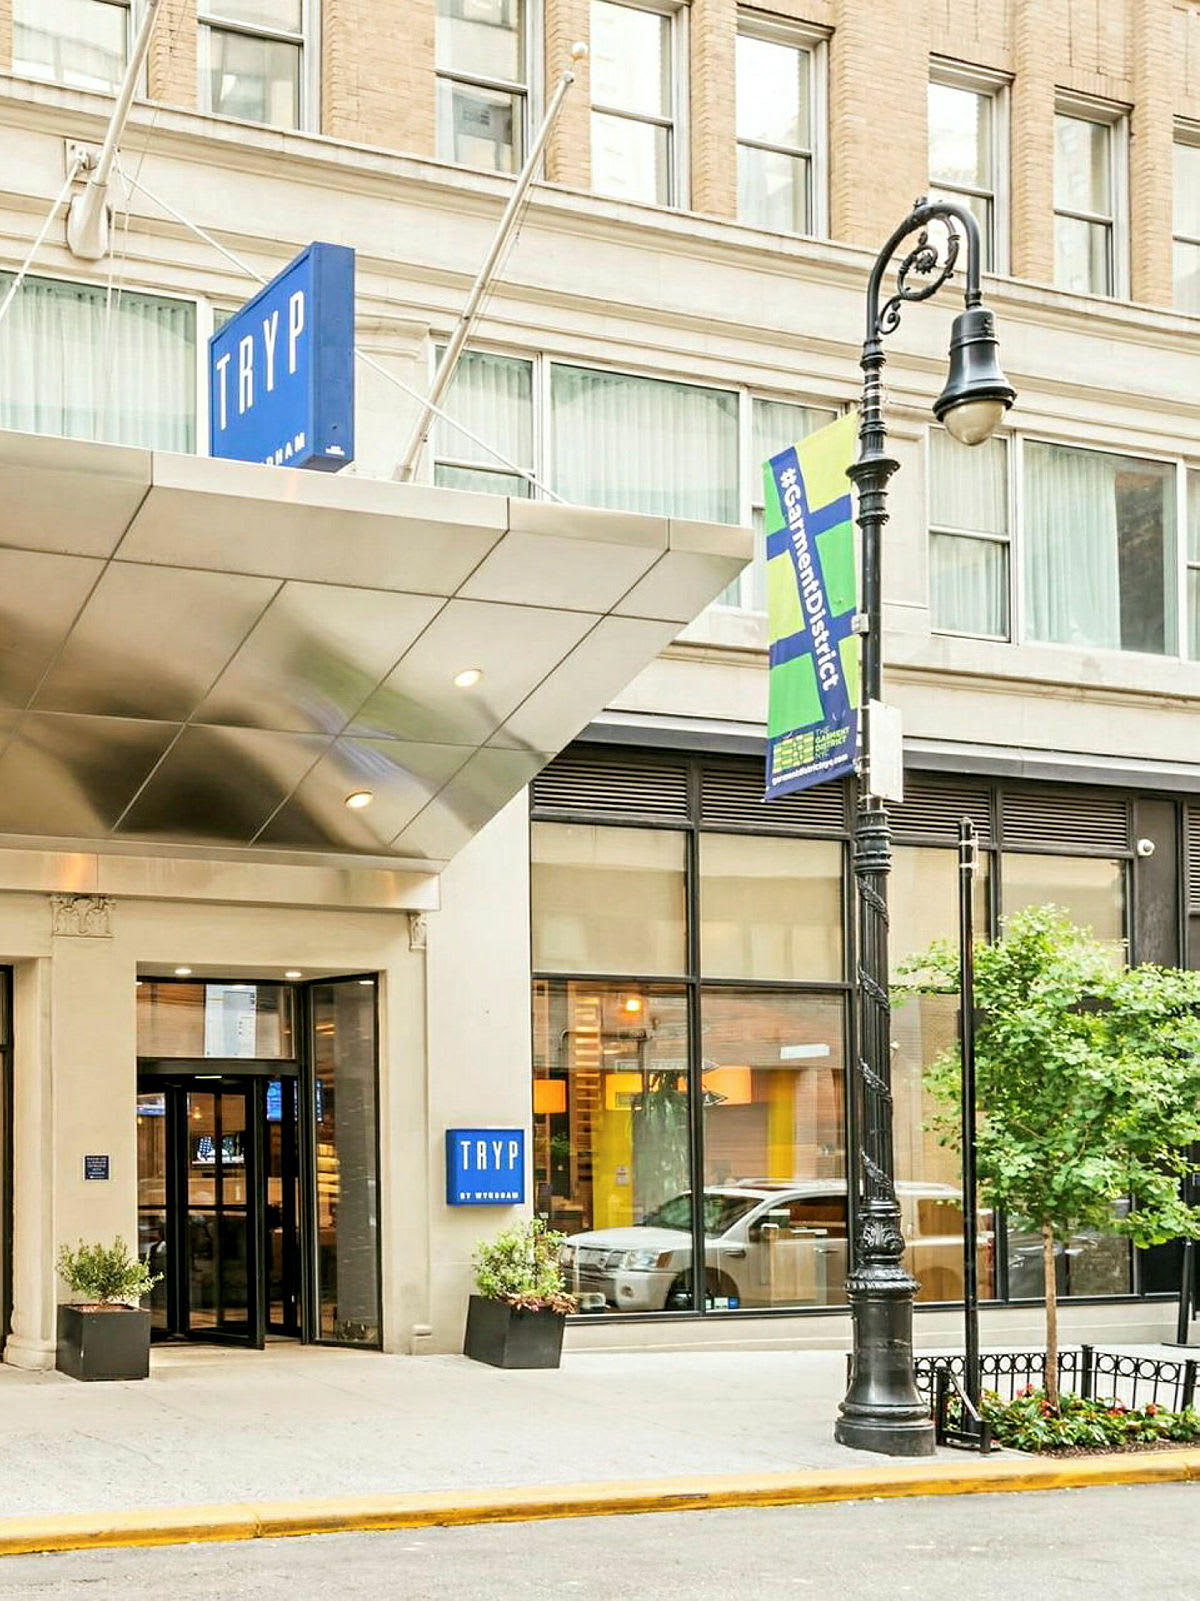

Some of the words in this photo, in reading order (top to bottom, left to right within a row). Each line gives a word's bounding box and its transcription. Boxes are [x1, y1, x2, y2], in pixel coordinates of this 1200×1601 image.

[216, 290, 305, 431] TRYP
[779, 467, 839, 692] #GarmentDistrict
[815, 726, 850, 743] GARMENT
[815, 735, 847, 752] DISTRICT
[460, 1141, 518, 1170] TRYP
[460, 1192, 471, 1200] BY
[476, 1192, 519, 1200] WYNDHAM
